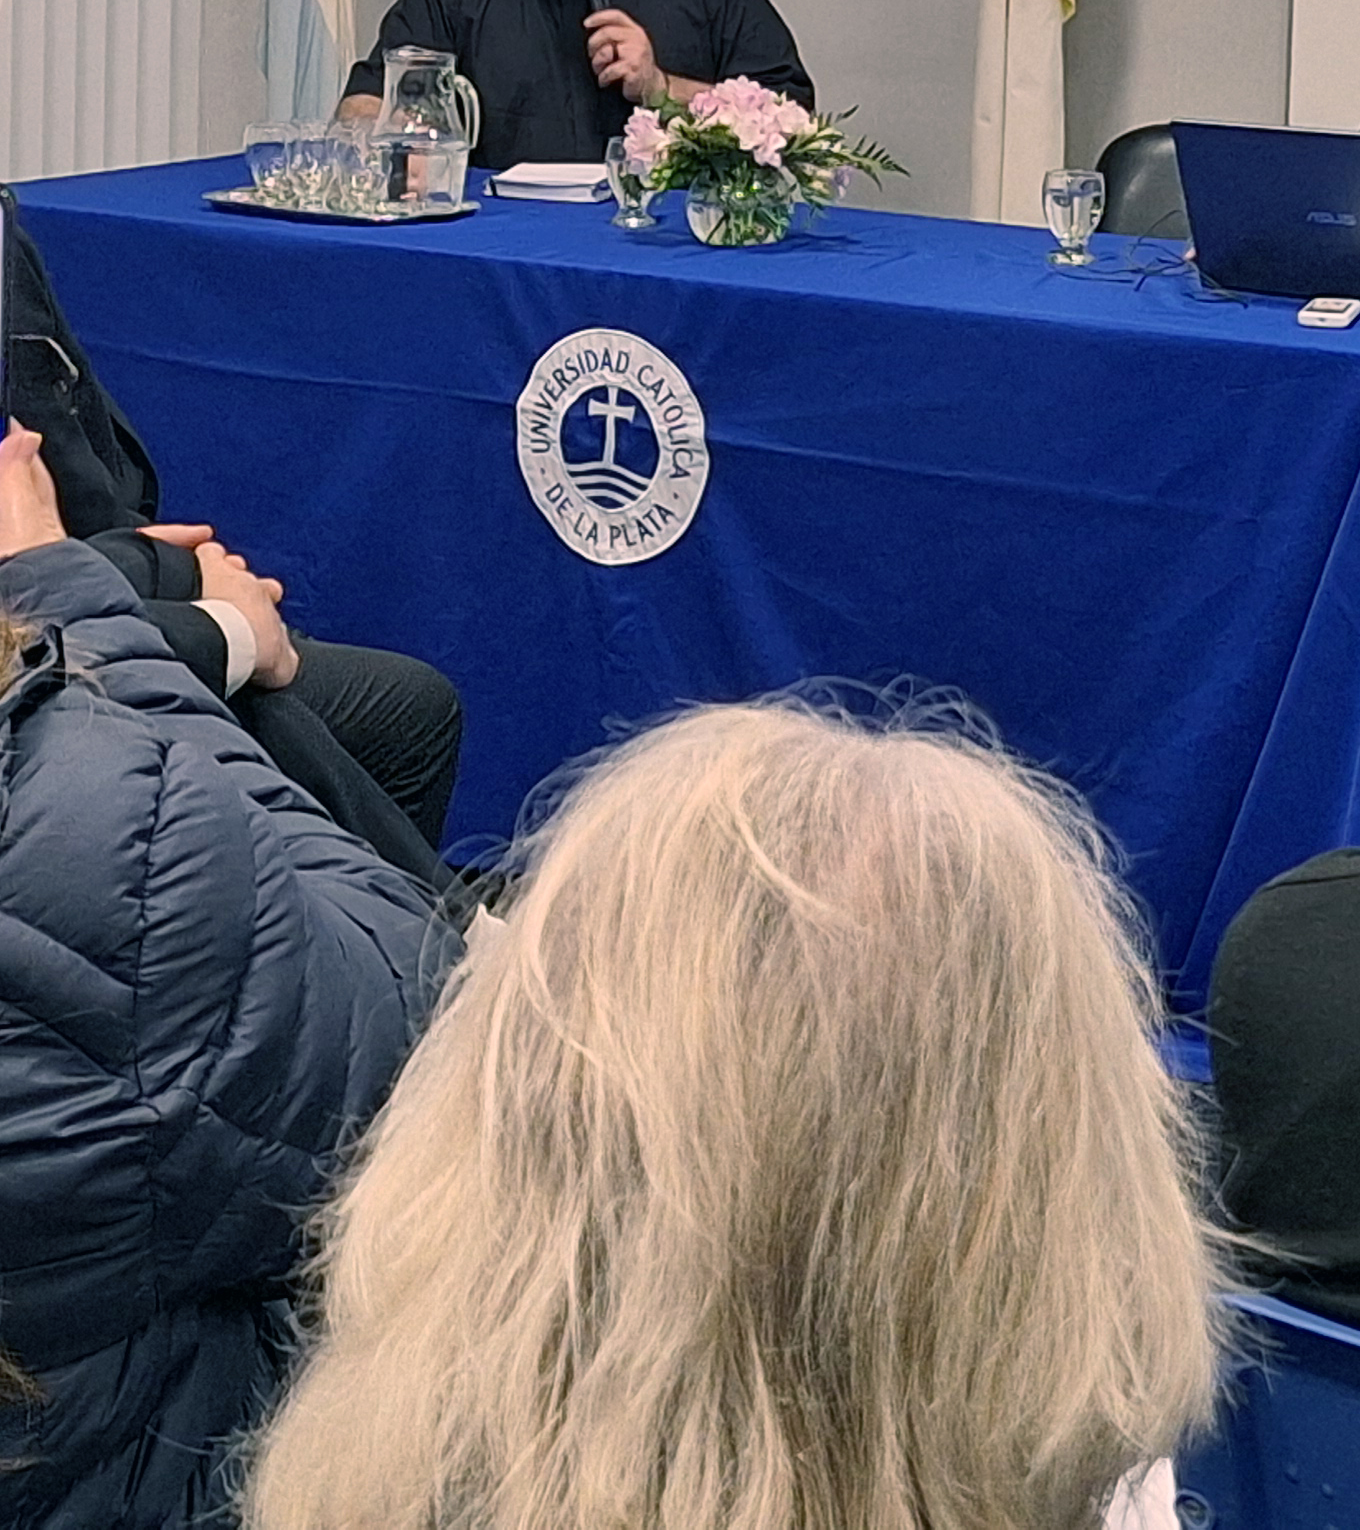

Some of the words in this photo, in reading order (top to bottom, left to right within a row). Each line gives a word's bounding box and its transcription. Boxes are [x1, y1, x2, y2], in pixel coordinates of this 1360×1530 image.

[530, 348, 630, 453] UNIVERSIDAD
[545, 482, 574, 516] DE
[573, 512, 599, 546] LA
[609, 503, 675, 549] PLATA
